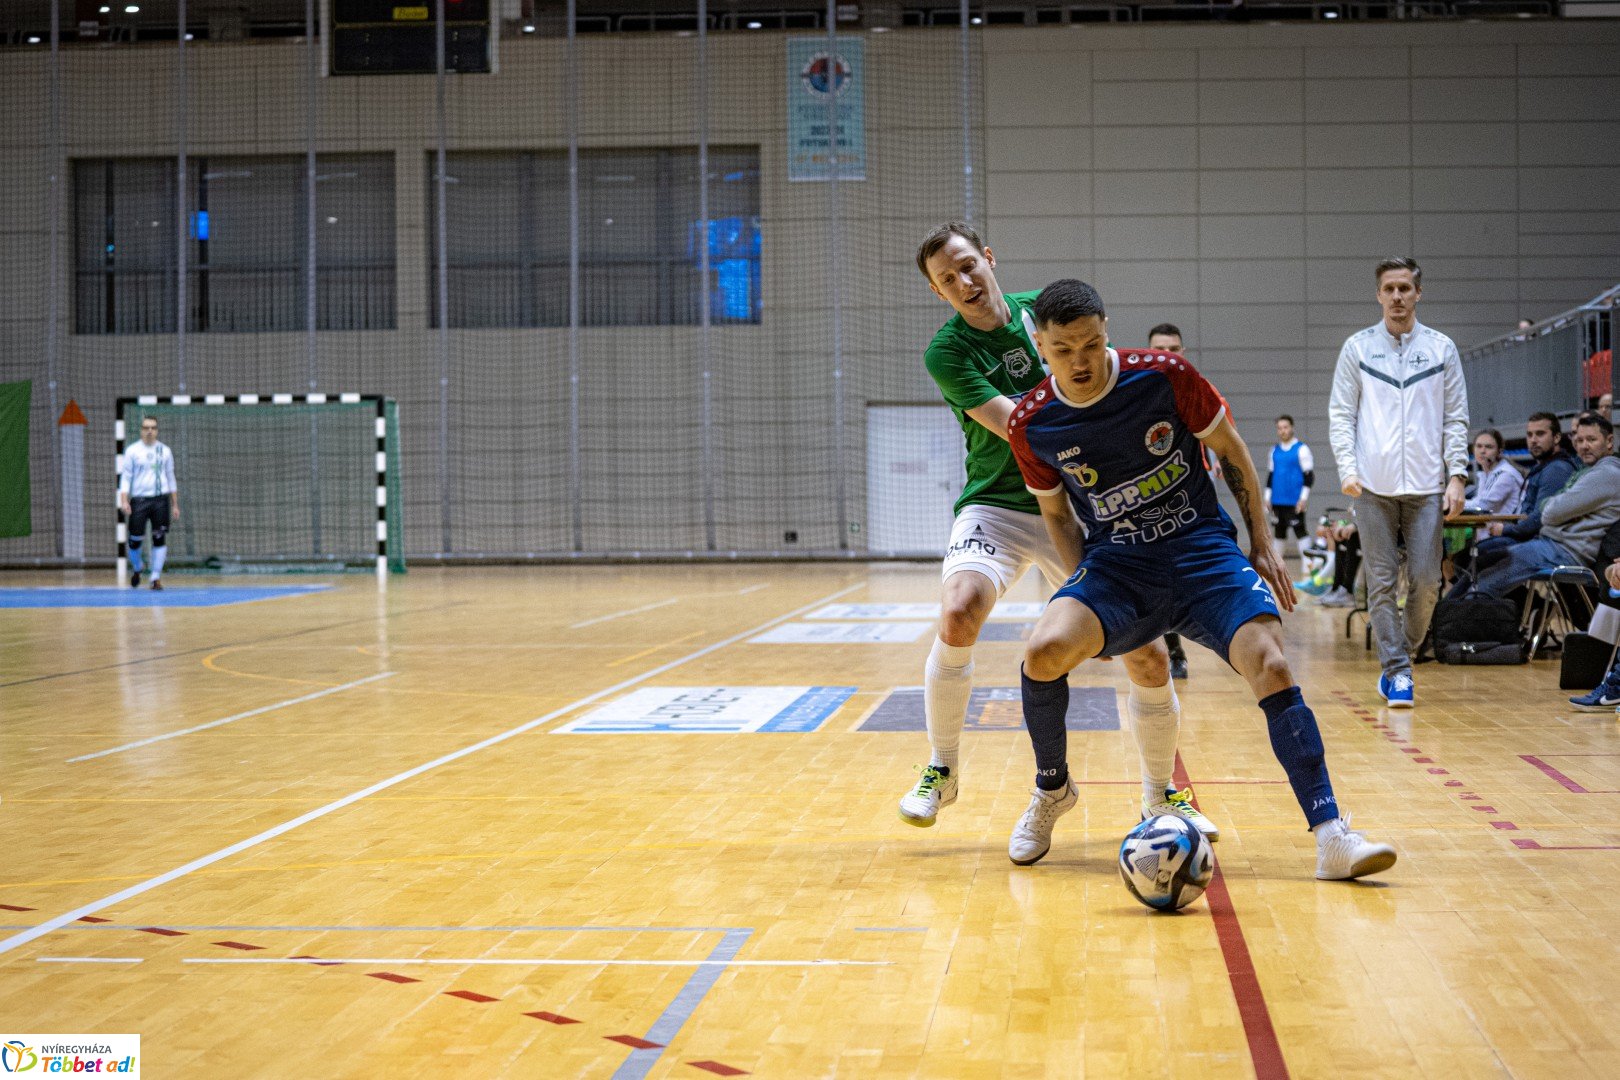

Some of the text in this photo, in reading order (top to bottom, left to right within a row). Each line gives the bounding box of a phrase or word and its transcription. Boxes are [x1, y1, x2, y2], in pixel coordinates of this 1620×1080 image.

[1056, 446, 1081, 461] JAKO
[1111, 507, 1198, 545] STUDIO
[1037, 768, 1057, 777] AKO
